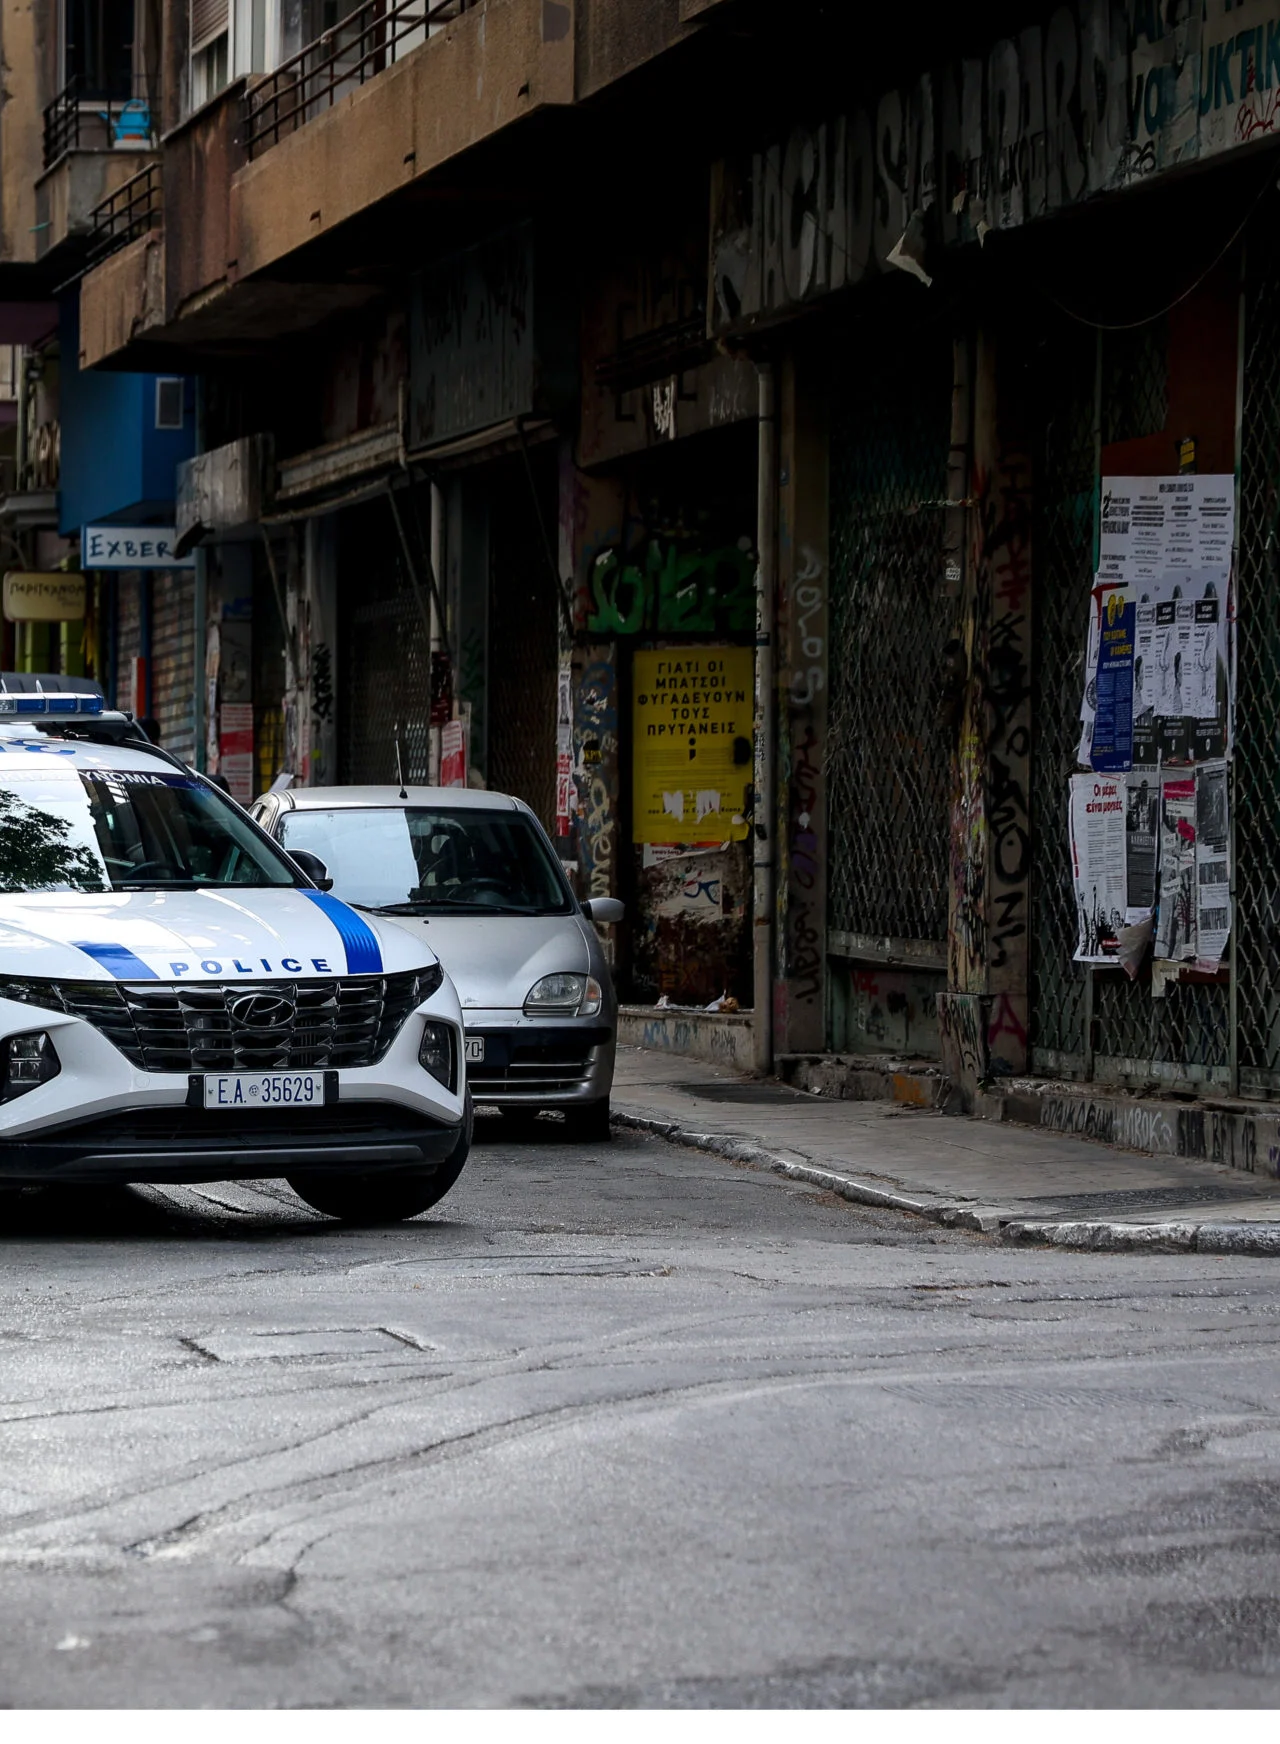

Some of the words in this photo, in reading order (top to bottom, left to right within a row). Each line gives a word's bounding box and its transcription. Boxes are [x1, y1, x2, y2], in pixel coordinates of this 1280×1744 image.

[90, 534, 193, 559] EXBER
[658, 662, 699, 674] ΓΙΑΤΙ
[708, 660, 723, 673] ΟΙ
[656, 676, 726, 689] ΜΠΑΤΣΟΙ
[638, 691, 745, 705] ΦΥΓΑΔΕΥΟΥΝ
[671, 707, 710, 720] ΤΟΥΣ
[647, 721, 736, 736] ΠΡΥΤΑΝΕΙΣ
[169, 957, 333, 977] POLICE
[261, 1077, 314, 1103] 35629
